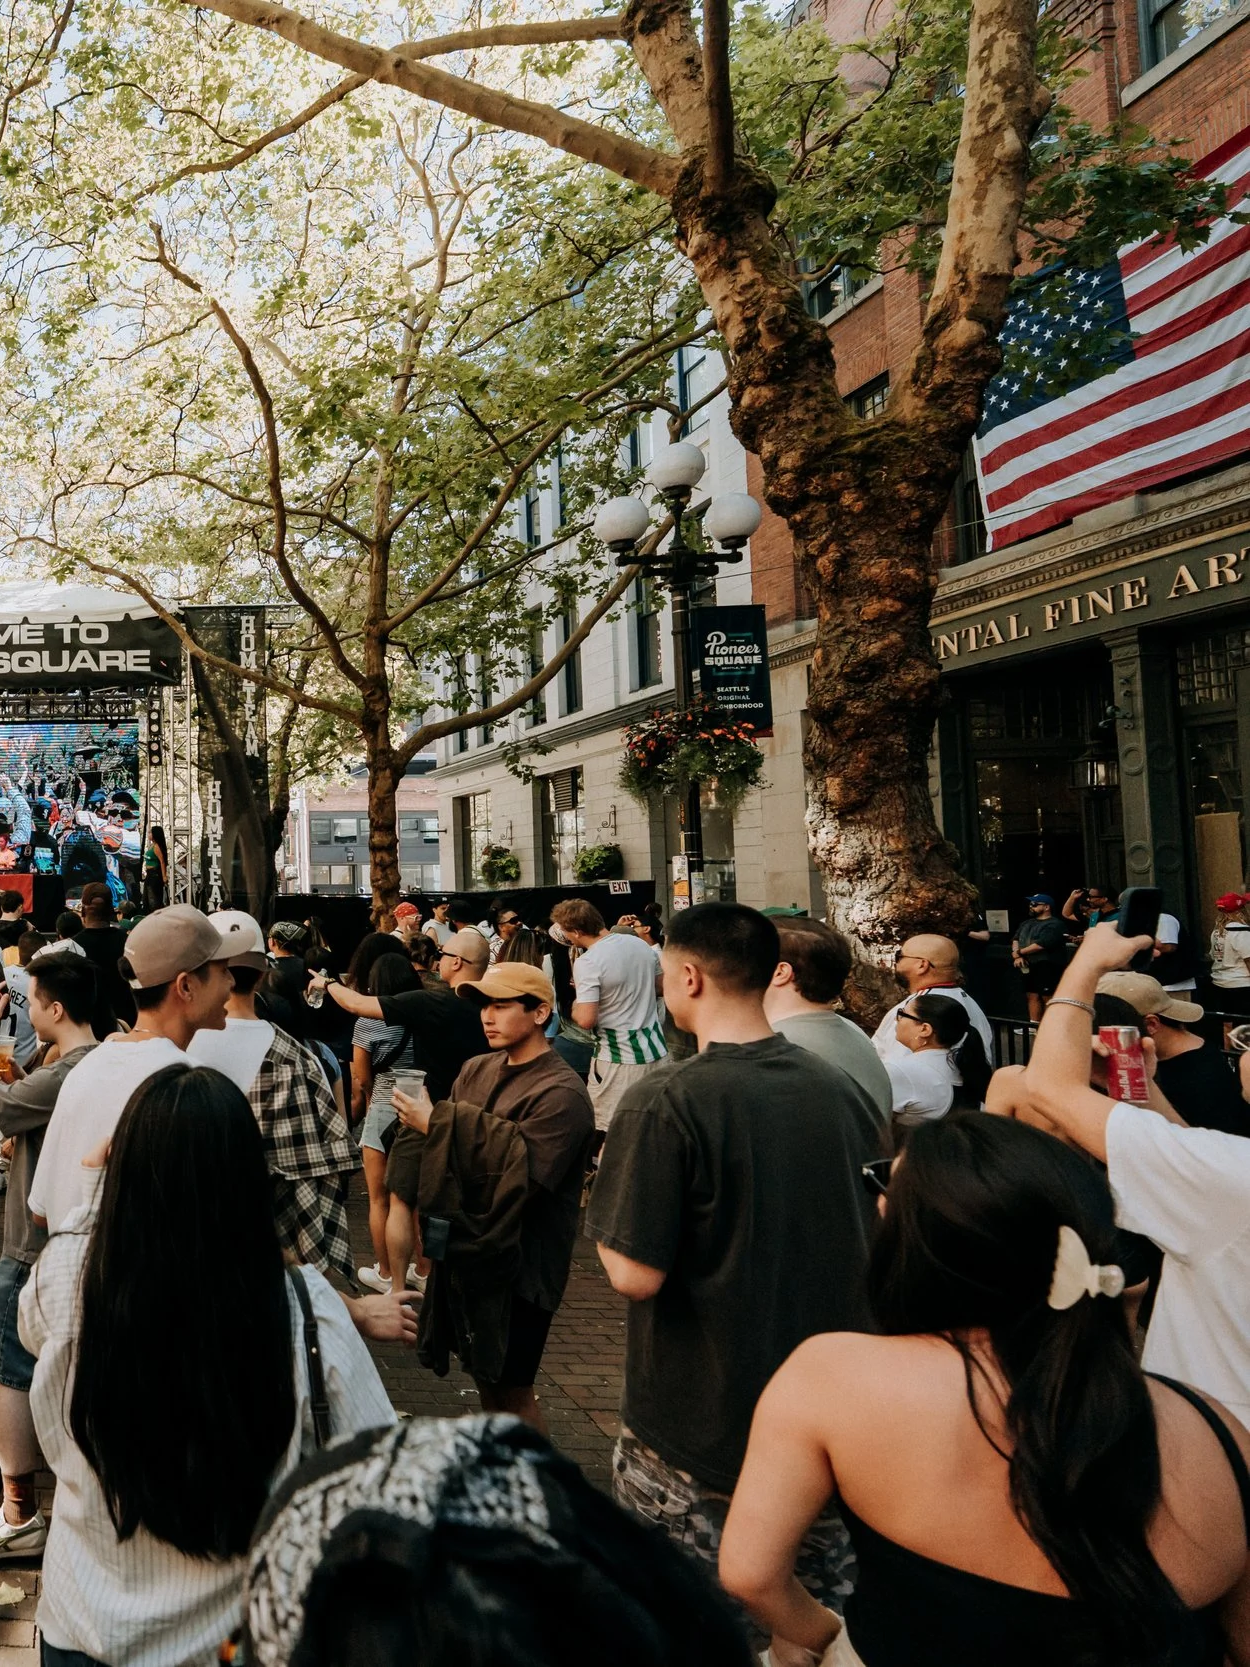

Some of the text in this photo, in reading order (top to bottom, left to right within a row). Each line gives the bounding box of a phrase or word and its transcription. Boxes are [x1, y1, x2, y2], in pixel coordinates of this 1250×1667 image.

[932, 612, 1030, 661] NTAL
[1042, 576, 1149, 633] FINE
[54, 622, 110, 645] TO
[704, 630, 761, 656] Pioneer
[704, 655, 763, 667] SQUARE
[239, 615, 260, 758] HOMTEAM
[716, 685, 750, 693] SEATTLE'S
[612, 881, 629, 893] EXIT
